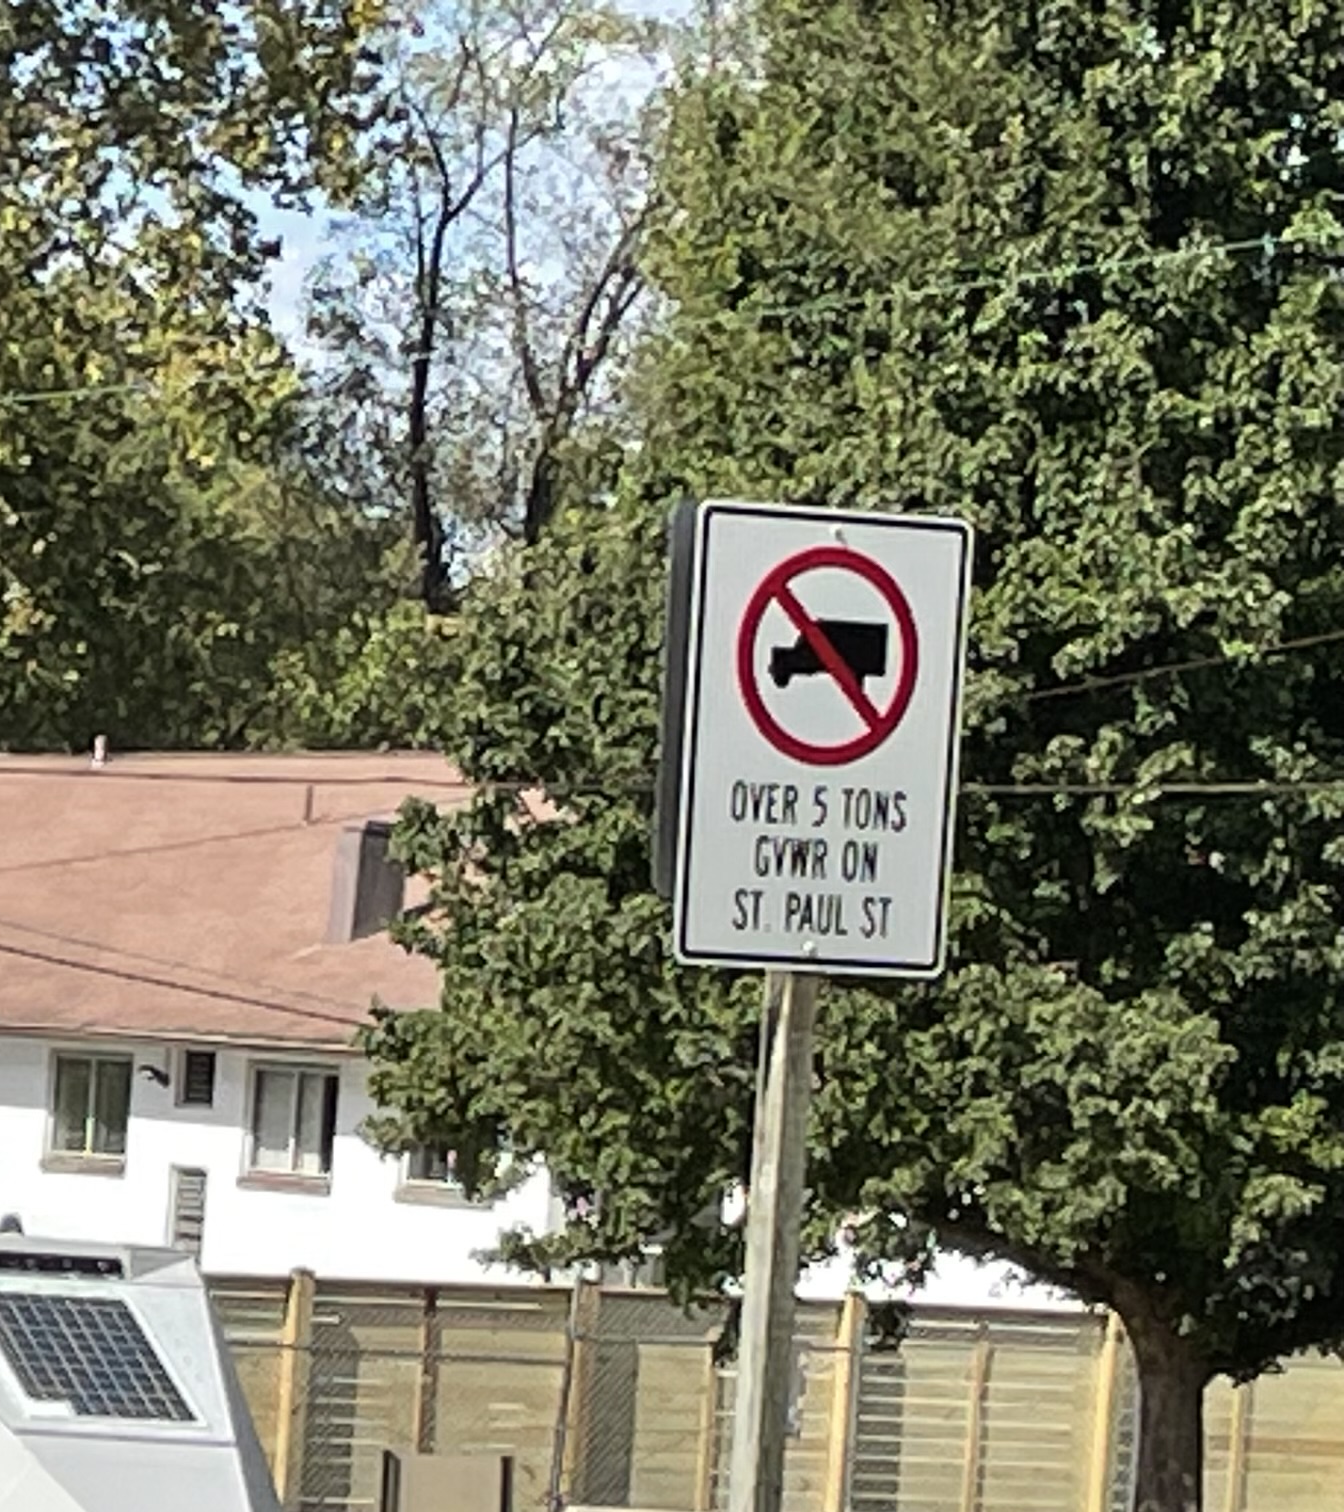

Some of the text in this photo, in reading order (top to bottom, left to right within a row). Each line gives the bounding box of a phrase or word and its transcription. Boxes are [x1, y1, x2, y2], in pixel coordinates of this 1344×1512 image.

[730, 779, 908, 832] OVER 5 TONS
[754, 835, 879, 883] GVWR ON
[784, 892, 848, 936] PAUL
[860, 896, 893, 939] ST
